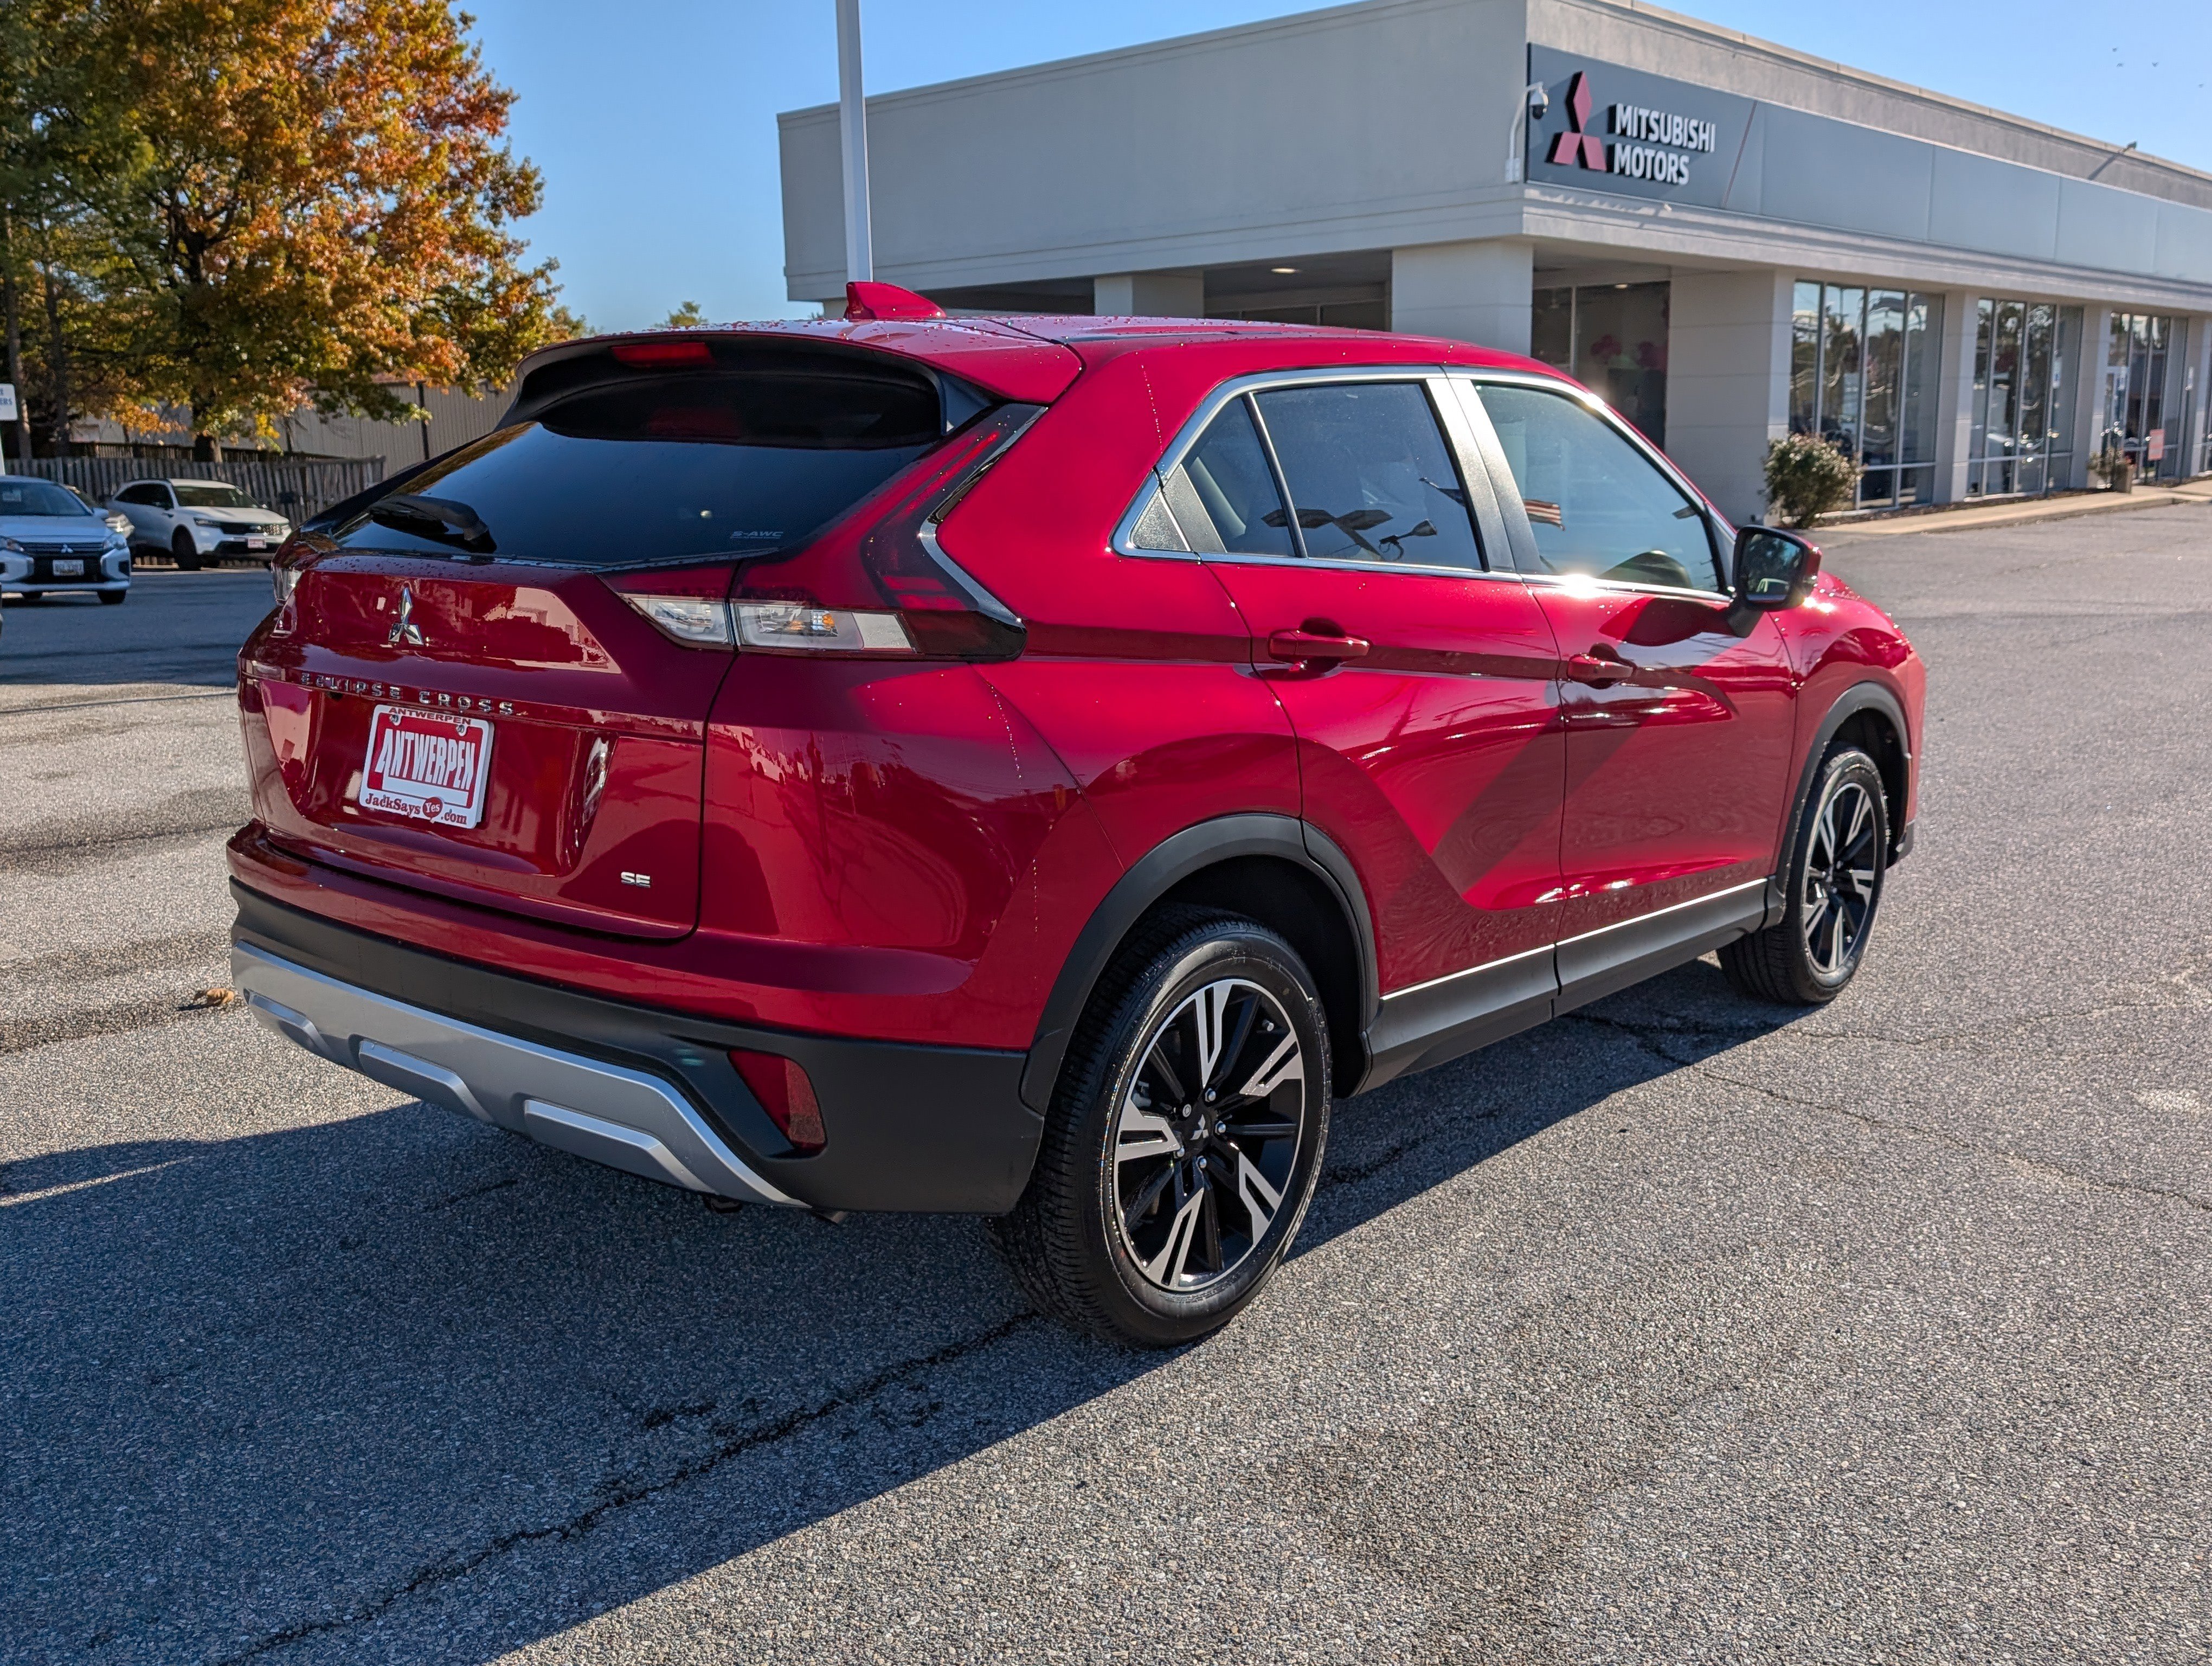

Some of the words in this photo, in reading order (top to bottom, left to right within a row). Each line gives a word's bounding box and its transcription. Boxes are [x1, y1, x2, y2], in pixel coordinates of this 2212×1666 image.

[1615, 103, 1716, 152] MITSUBISHI
[1613, 143, 1690, 185] MOTORS
[301, 672, 402, 700] ECLIPSE
[419, 690, 514, 715] CROSS
[389, 707, 471, 725] ANTWERPEN
[375, 728, 475, 790] ANTWERPEN
[621, 872, 651, 888] SE
